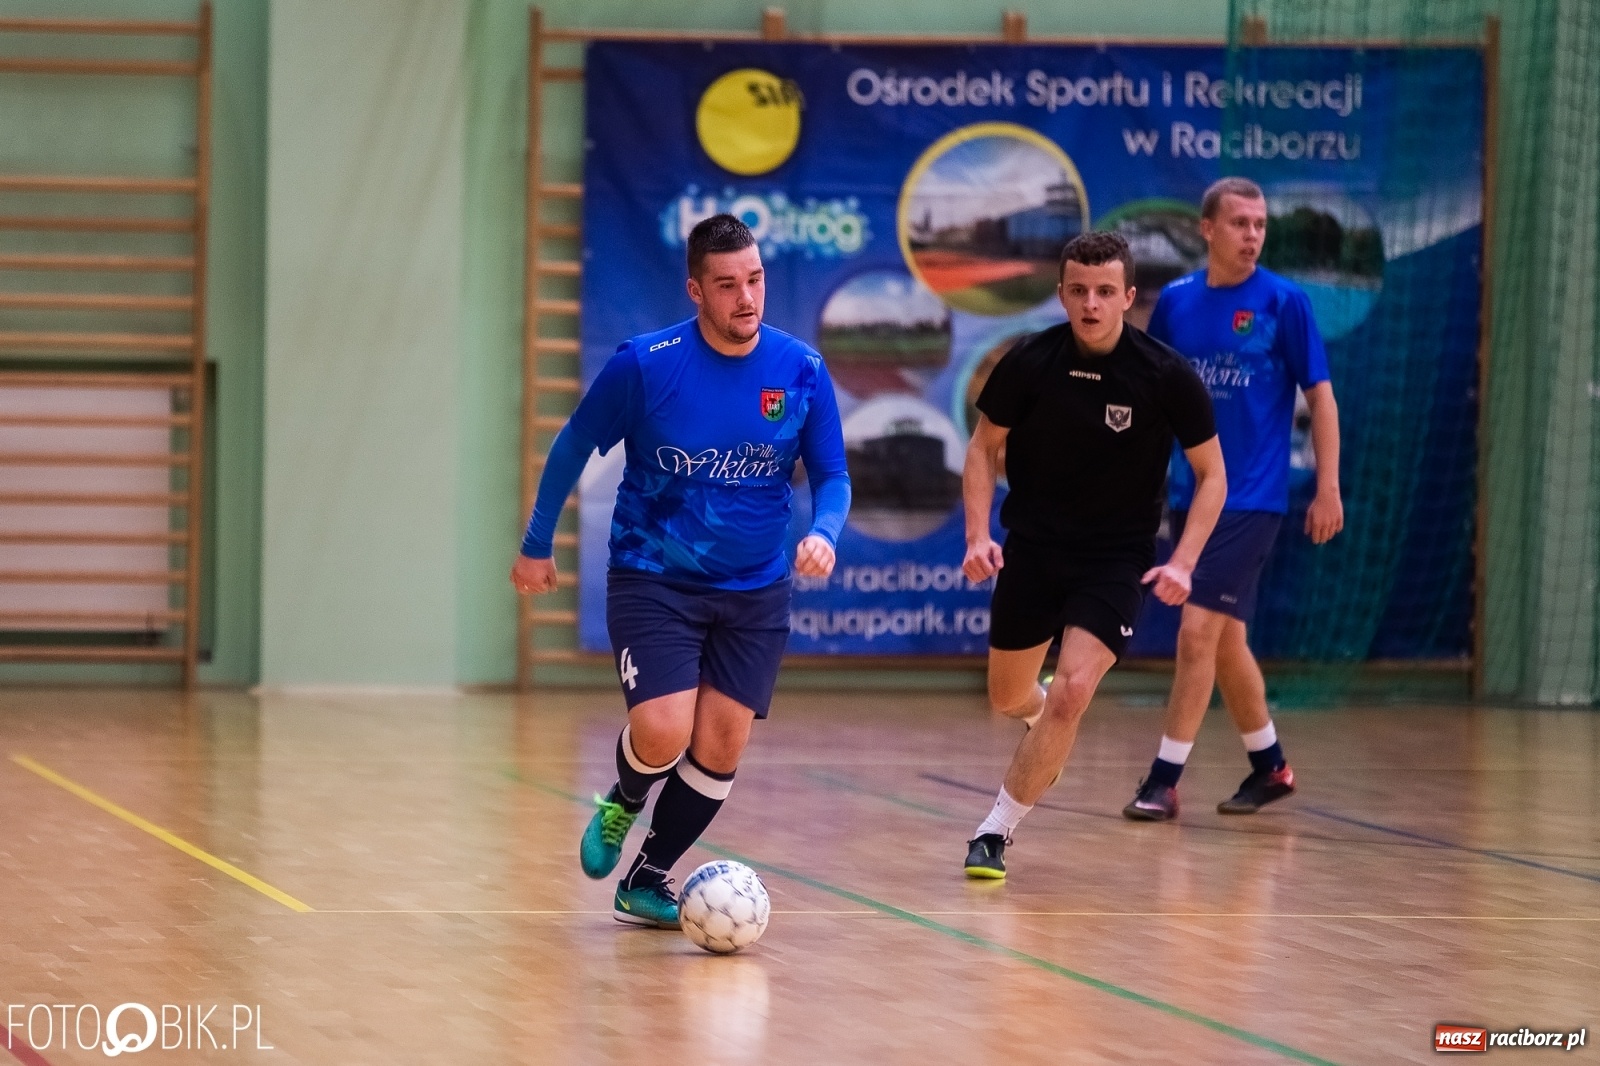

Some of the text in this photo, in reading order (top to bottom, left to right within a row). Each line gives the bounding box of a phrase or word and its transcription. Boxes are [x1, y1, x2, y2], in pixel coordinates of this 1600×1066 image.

[847, 67, 1363, 117] Ośrodek Sportu i Rekreacji
[1122, 121, 1361, 160] w Raciborzu
[649, 336, 682, 352] COLO
[620, 646, 639, 691] 4
